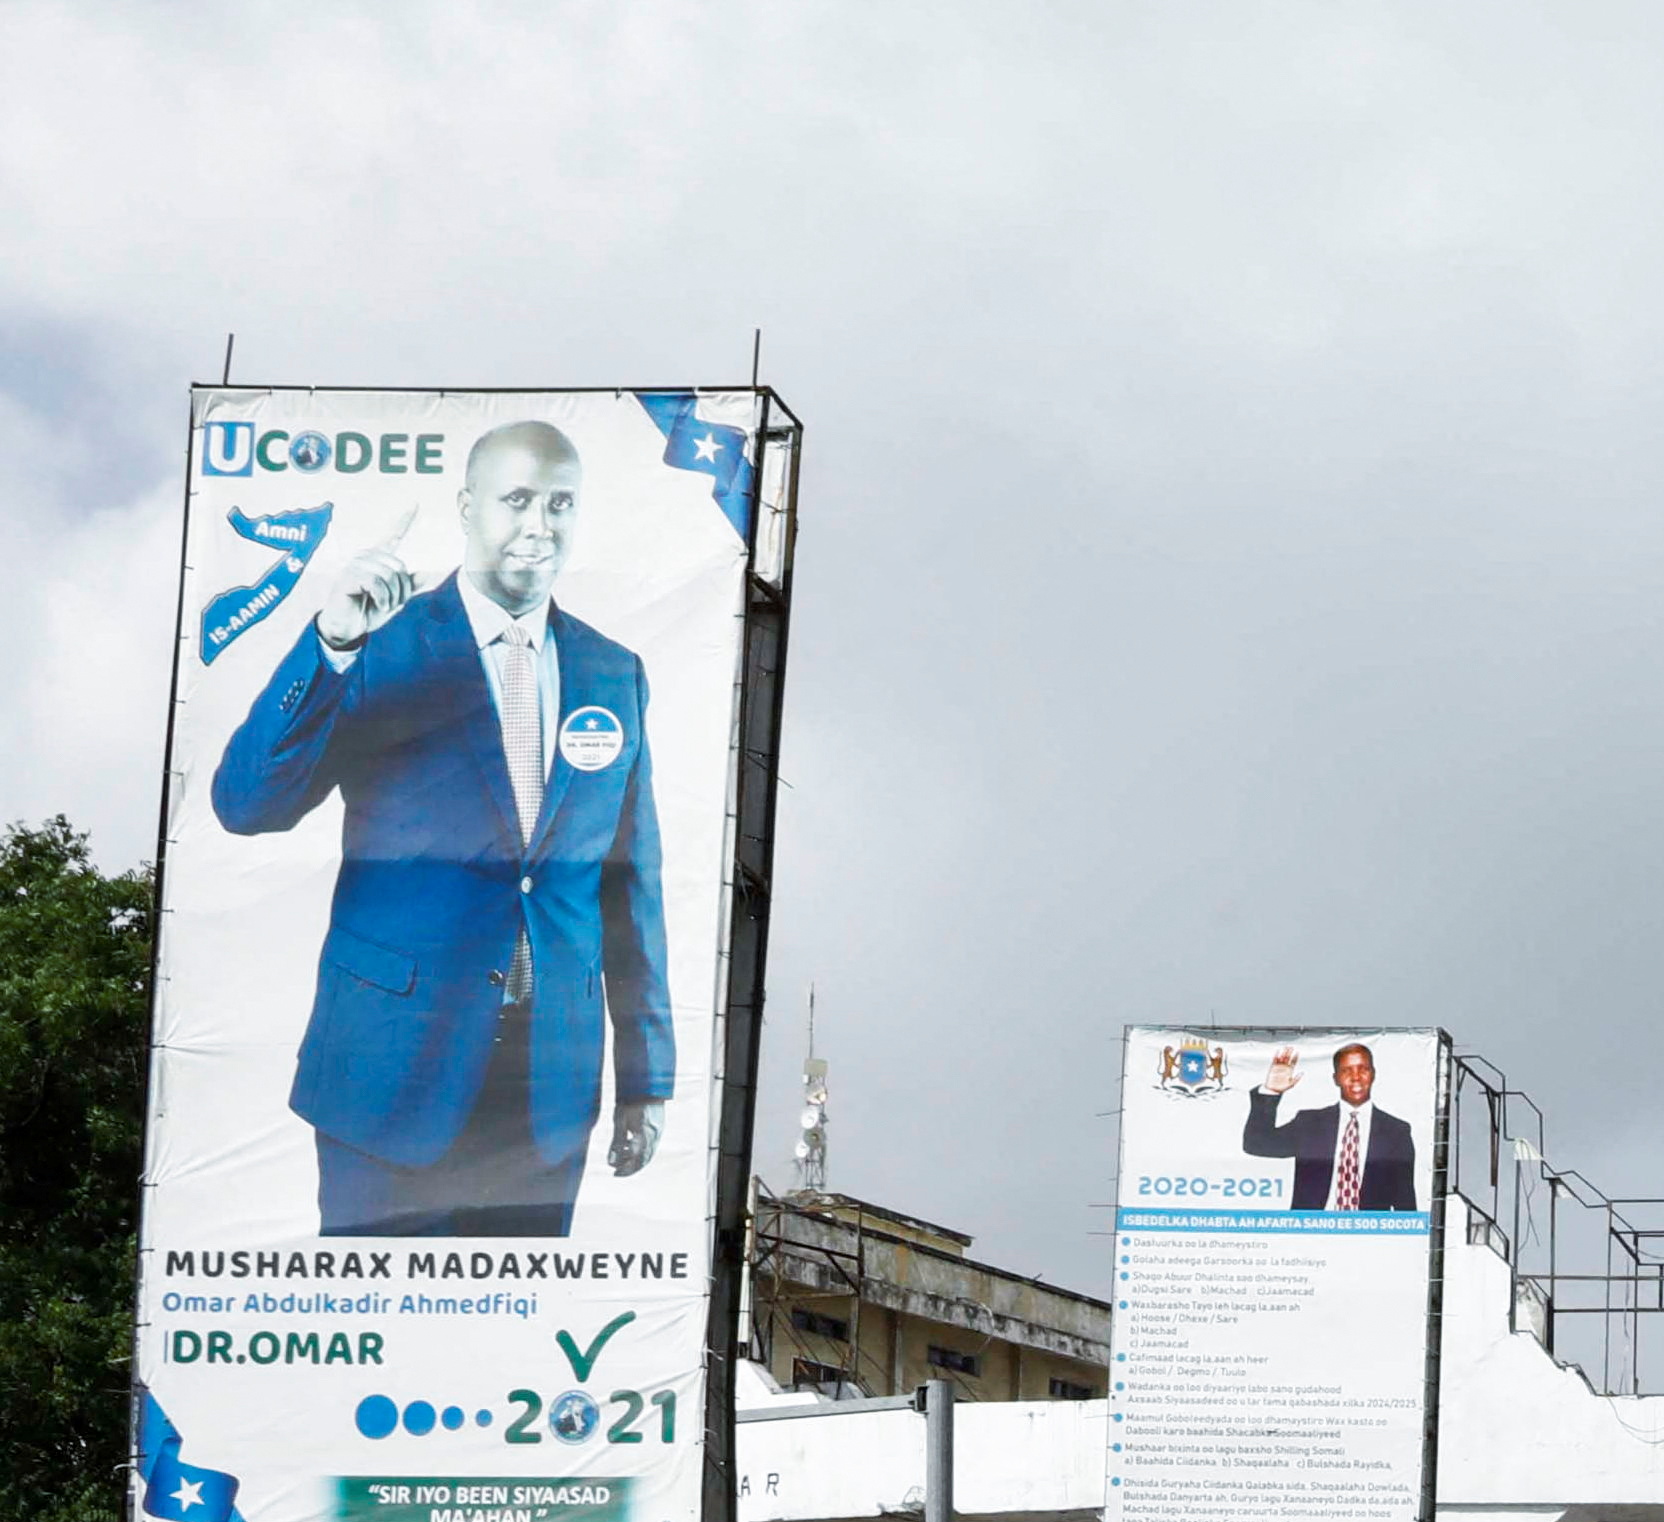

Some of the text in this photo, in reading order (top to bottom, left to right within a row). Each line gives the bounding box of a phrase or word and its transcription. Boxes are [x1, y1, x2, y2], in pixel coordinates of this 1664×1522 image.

[255, 522, 307, 542] Amni
[208, 584, 281, 644] IS-AAMIN
[1138, 1176, 1283, 1198] 2020-2021
[166, 1251, 688, 1279] MUSHARAX MADAXWEYNE
[162, 1292, 537, 1319] Omar Abdulkadir Ahmedfiqi
[173, 1330, 384, 1365] DR.OMAR
[504, 1389, 677, 1444] 2021
[416, 1486, 450, 1504] IYO
[456, 1486, 508, 1504] BEEN
[513, 1486, 610, 1505] SIYAASAD
